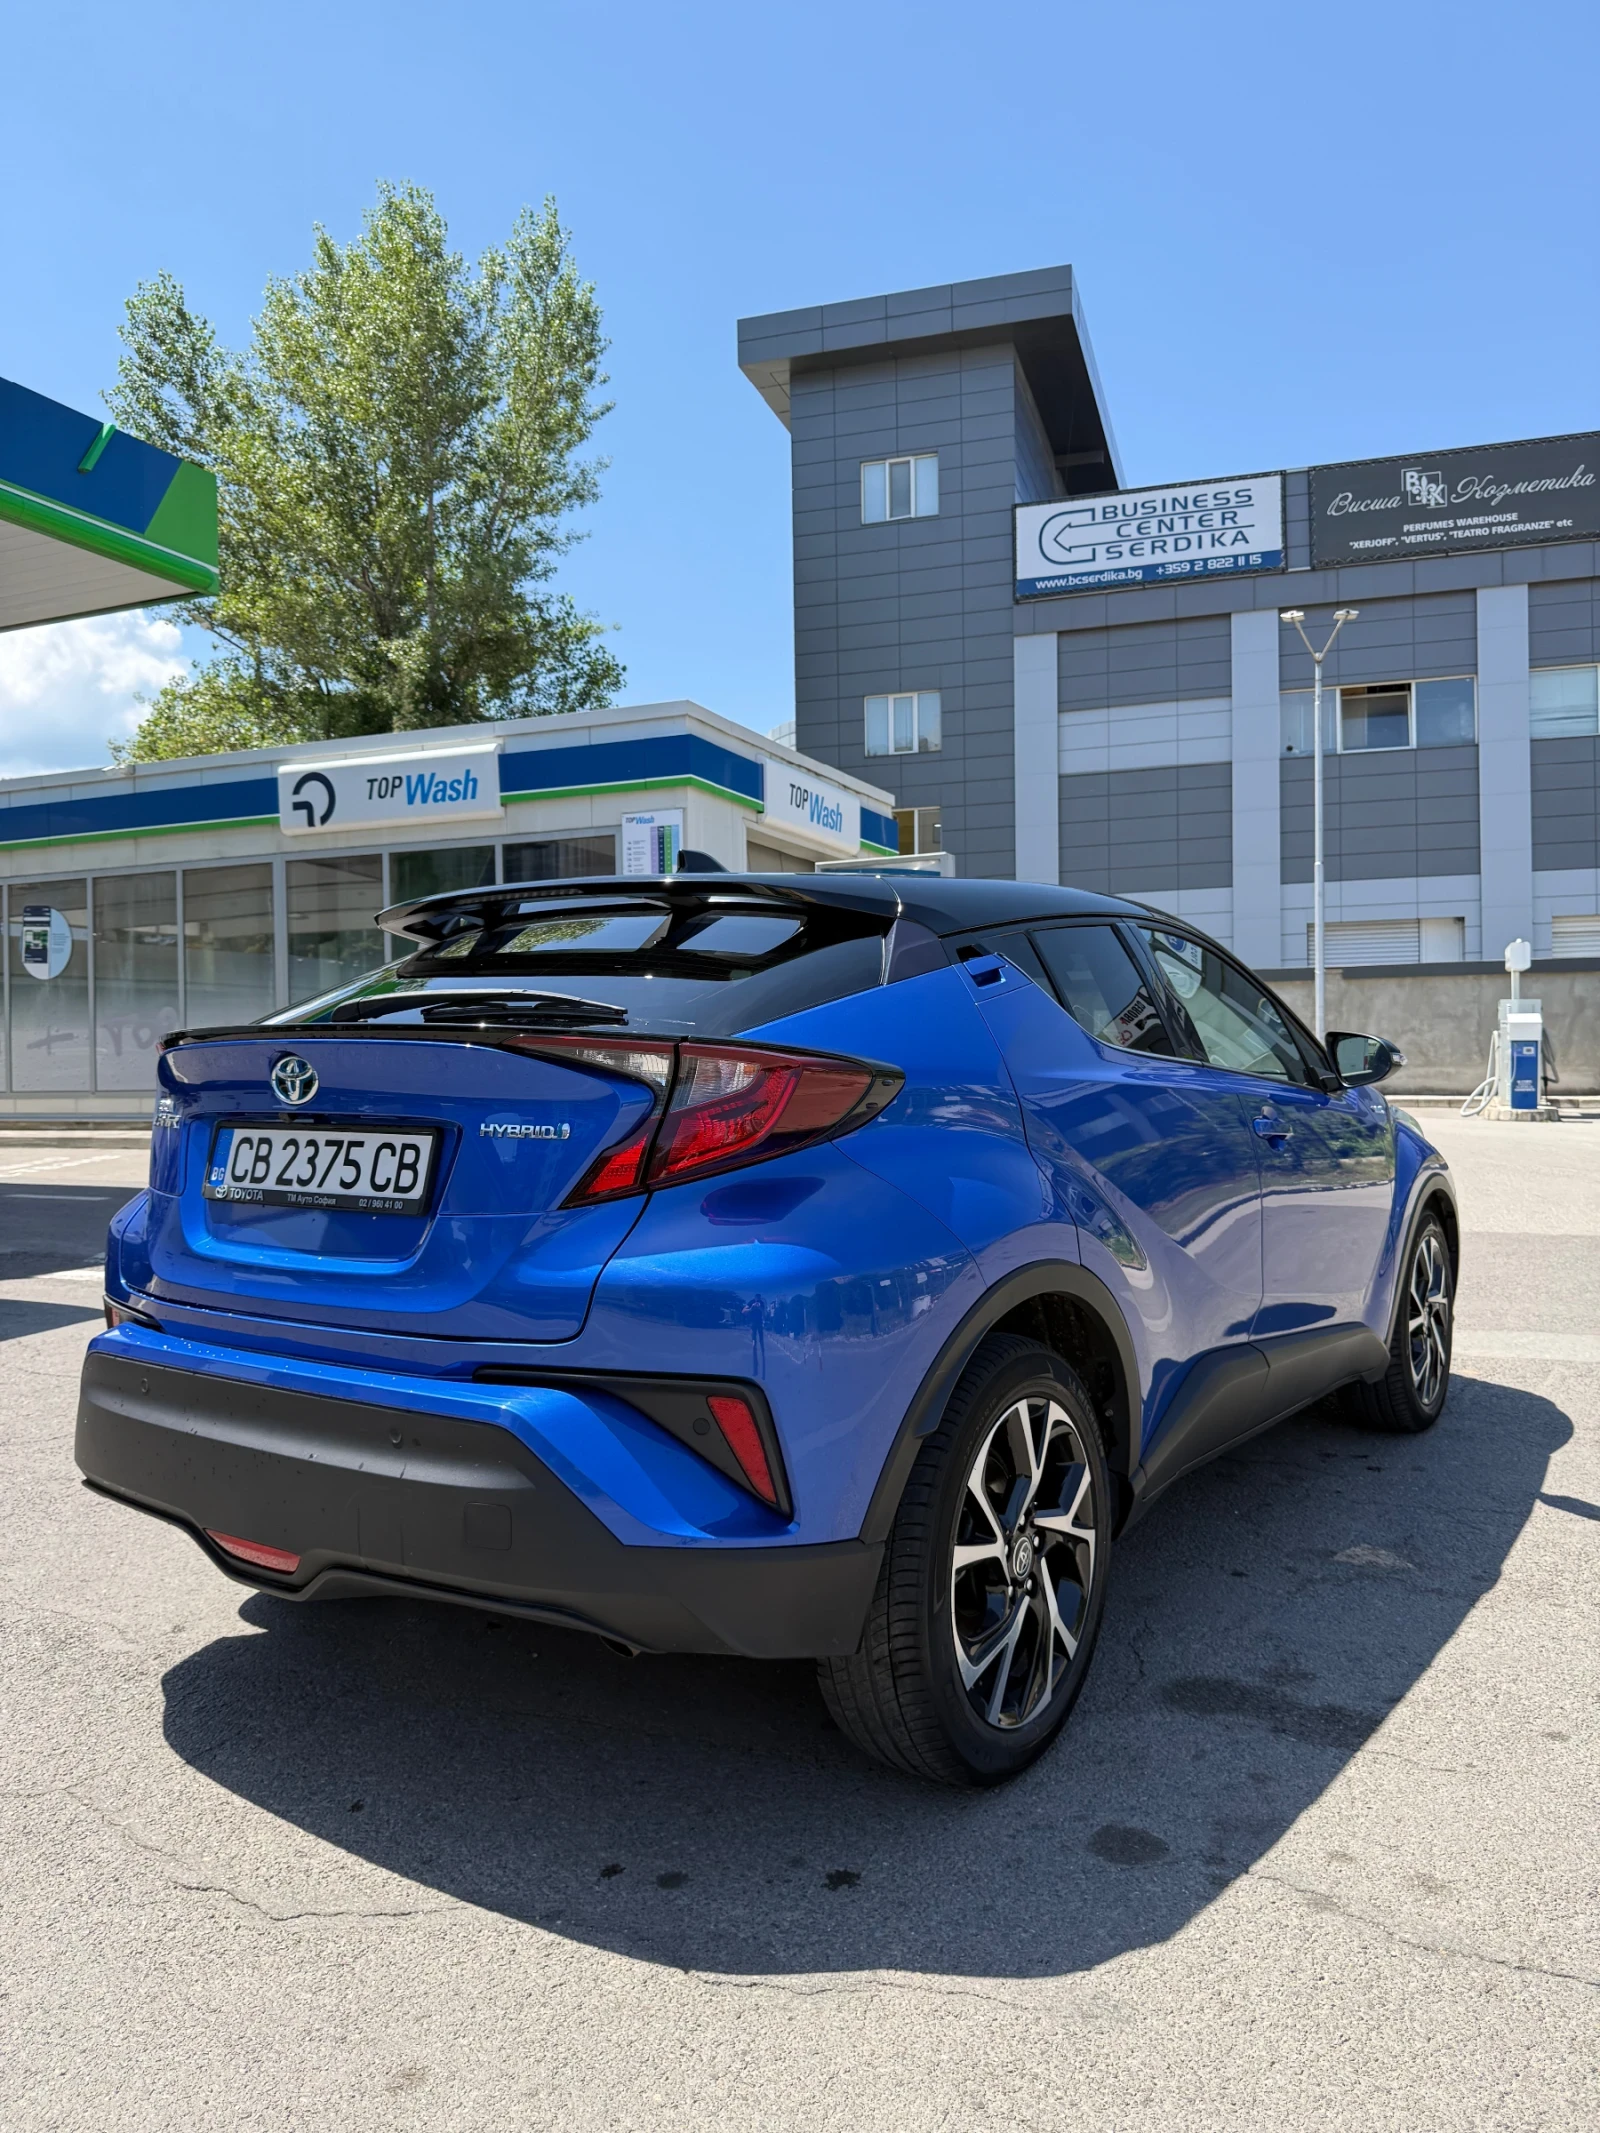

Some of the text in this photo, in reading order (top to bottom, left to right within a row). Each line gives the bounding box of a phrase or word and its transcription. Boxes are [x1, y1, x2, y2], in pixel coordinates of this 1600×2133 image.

[1326, 491, 1402, 517] Висша
[1450, 464, 1597, 506] Козметика
[1102, 488, 1253, 521] BUSINESS
[1116, 510, 1239, 538] CENTER
[1402, 512, 1519, 533] PERFUMES WAREHOUSE
[1556, 518, 1573, 528] etc
[1105, 530, 1250, 561] SERDIKA
[1035, 554, 1262, 590] www.bcserdika.bg +359 2 822 11 15
[480, 1123, 556, 1139] HYBRID
[211, 1167, 225, 1181] BG
[231, 1136, 421, 1194] CB 2375 CB
[230, 1187, 263, 1201] TOYOTA
[297, 1194, 312, 1205] Ауто
[313, 1195, 336, 1206] София
[359, 1199, 367, 1207] 02
[384, 1200, 393, 1209] 41
[394, 1201, 403, 1210] 00
